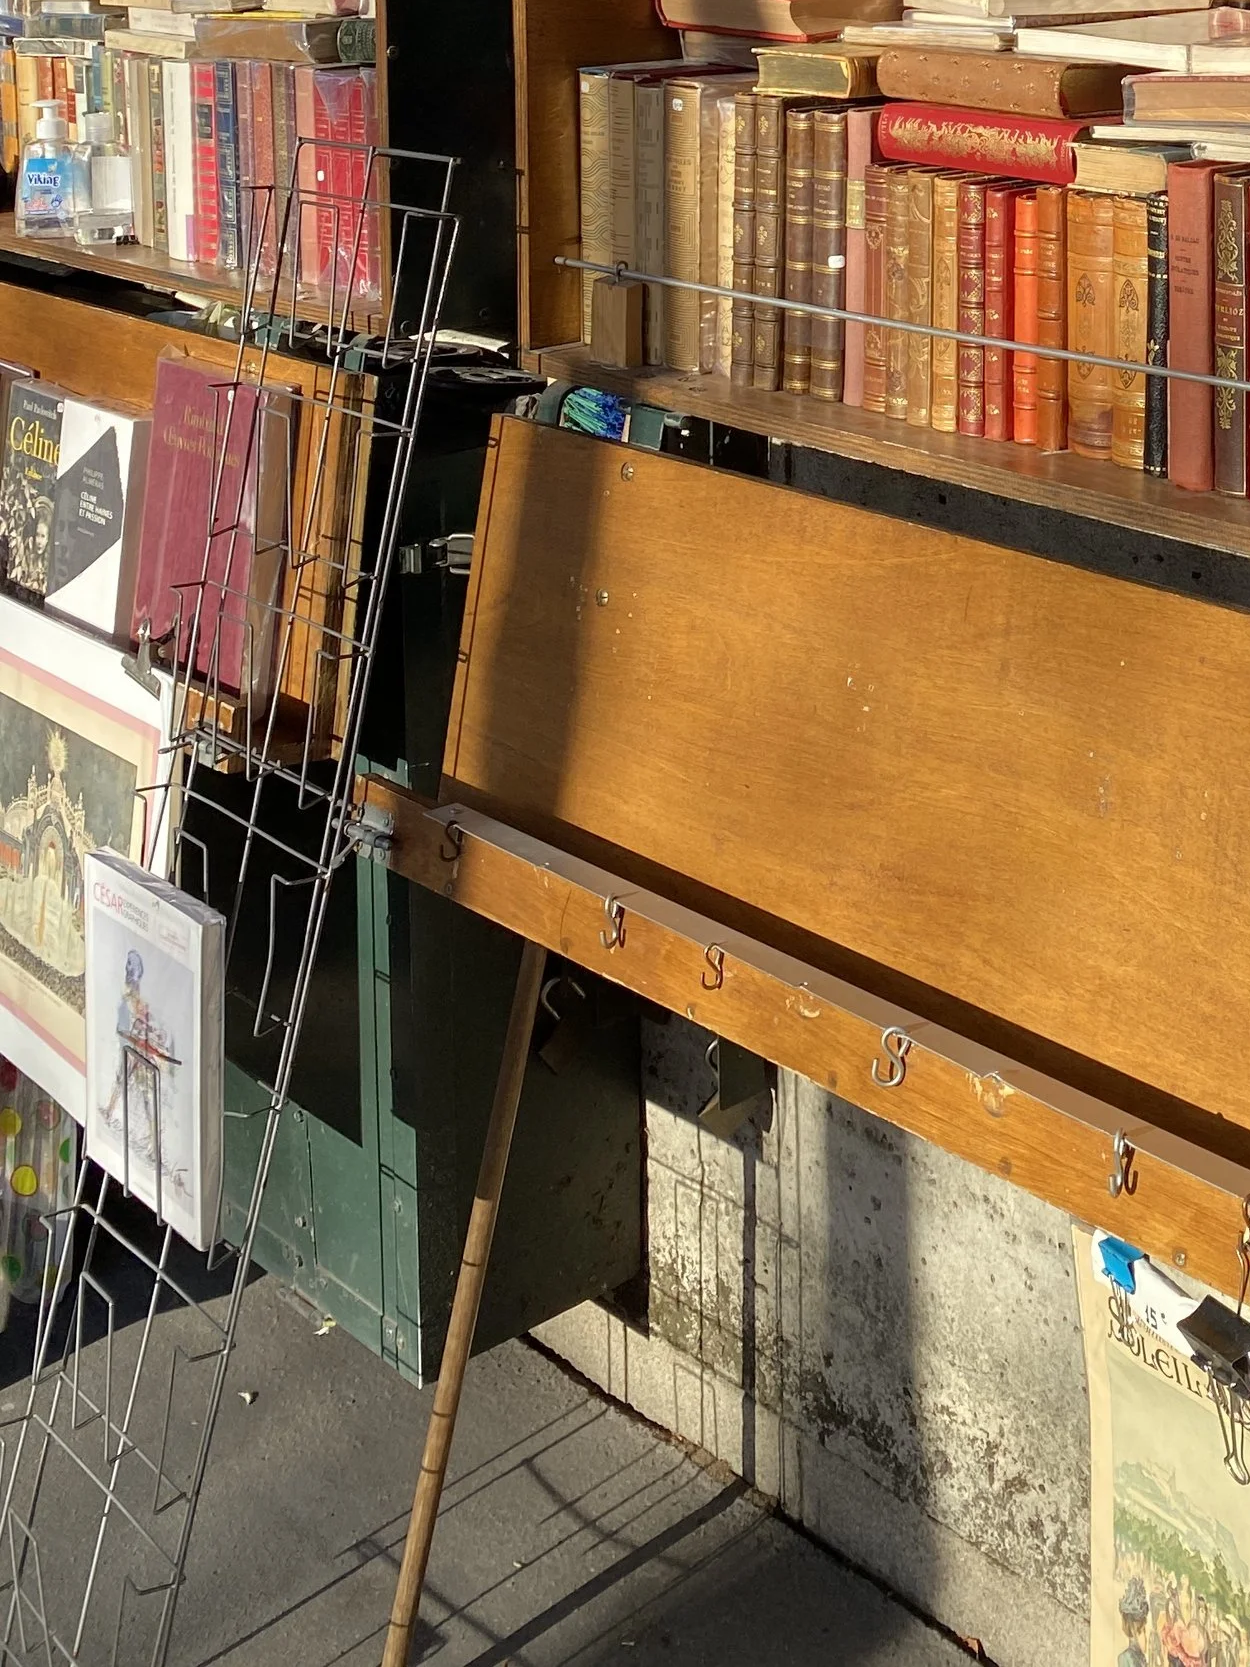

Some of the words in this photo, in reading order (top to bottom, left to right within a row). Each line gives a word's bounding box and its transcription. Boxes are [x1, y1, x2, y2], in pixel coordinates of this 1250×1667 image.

[27, 172, 60, 188] Viking
[10, 416, 61, 468] Céline
[80, 490, 98, 504] CÉLINE
[79, 500, 95, 513] ENTRE
[78, 508, 86, 518] ET
[85, 510, 107, 527] PASSION
[94, 881, 124, 915] CÉSAR
